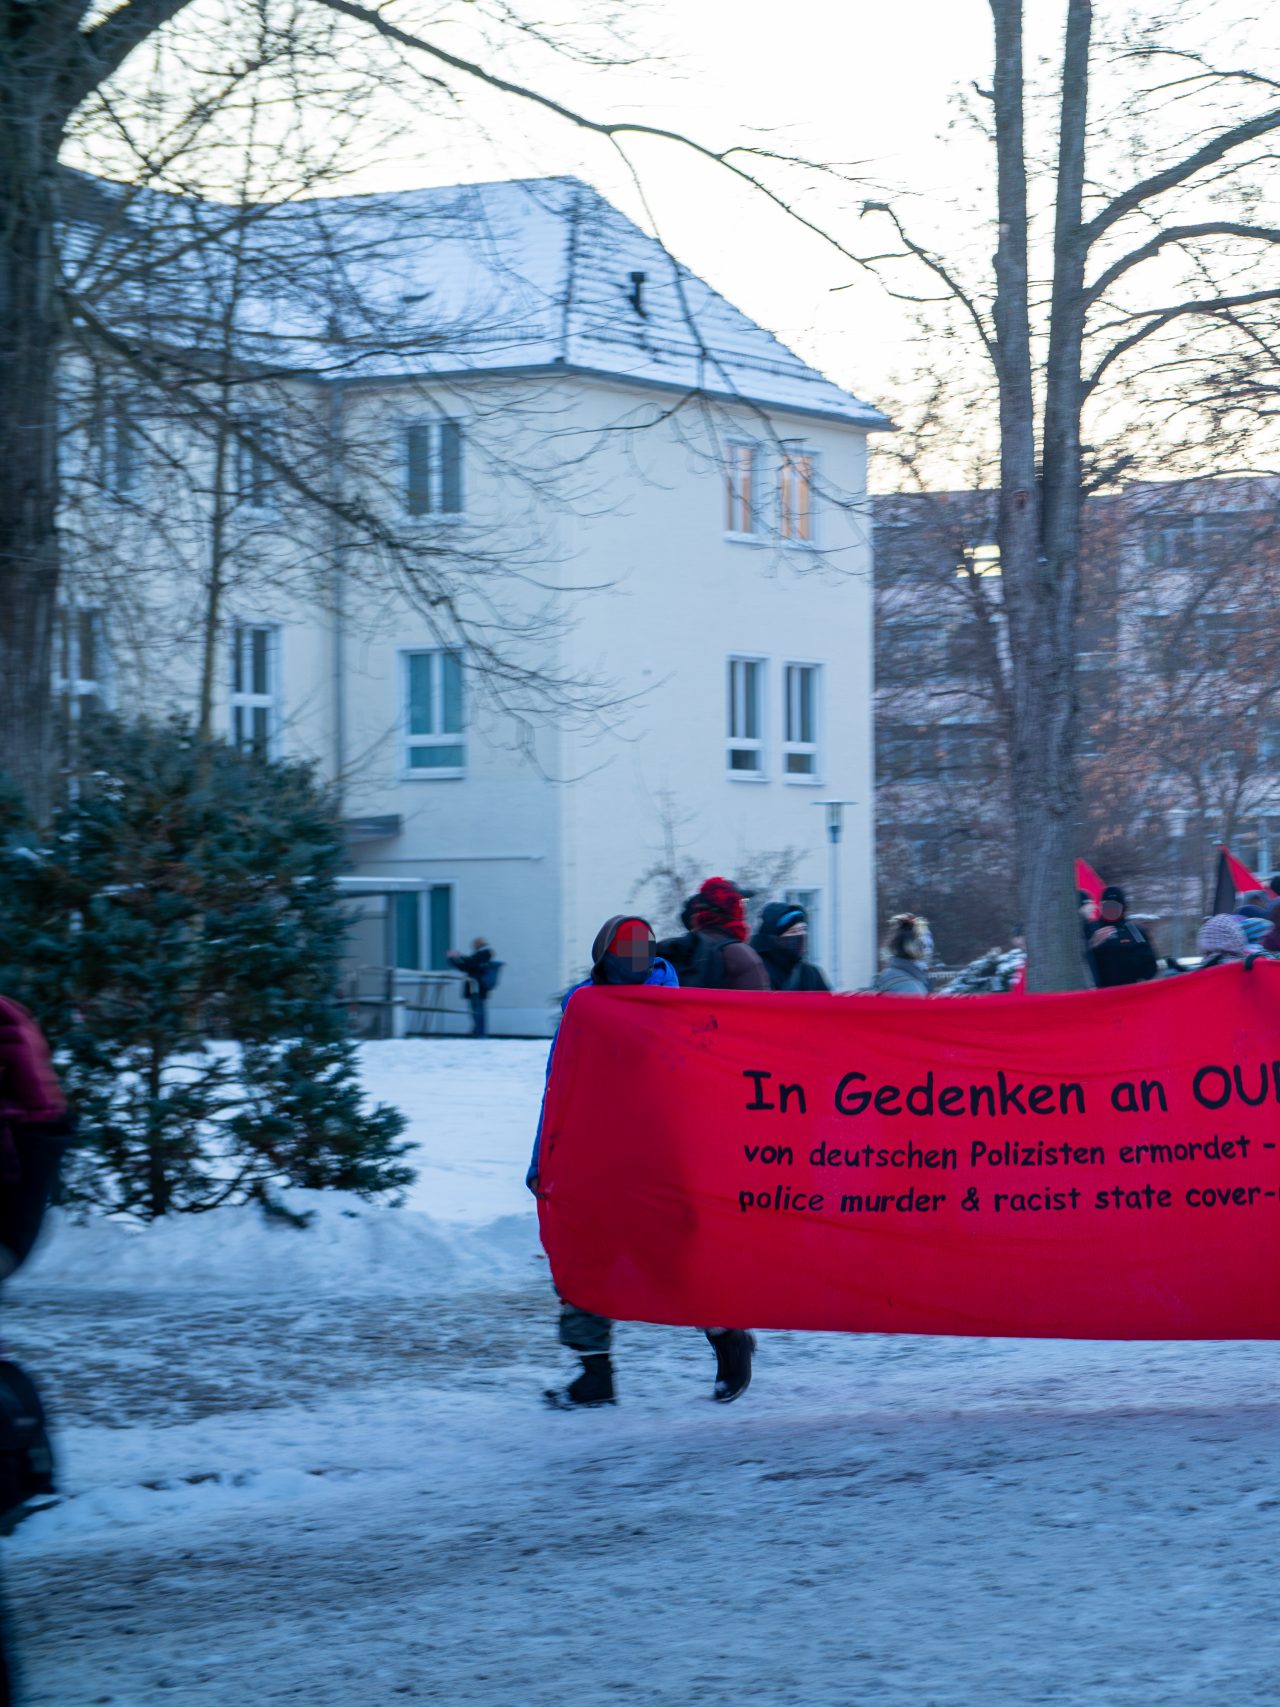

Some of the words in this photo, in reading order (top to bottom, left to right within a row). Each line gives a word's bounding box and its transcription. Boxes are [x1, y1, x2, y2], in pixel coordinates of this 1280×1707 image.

[742, 1069, 807, 1115] In
[834, 1070, 1086, 1118] Gedenken
[1110, 1079, 1169, 1113] an
[743, 1144, 794, 1166] von
[809, 1139, 957, 1170] deutschen
[970, 1140, 1105, 1168] Polizisten
[1119, 1134, 1251, 1165] ermordet
[738, 1184, 825, 1213] police
[839, 1186, 947, 1213] murder
[960, 1186, 980, 1212] &
[993, 1186, 1081, 1213] racist
[1094, 1183, 1172, 1210] state
